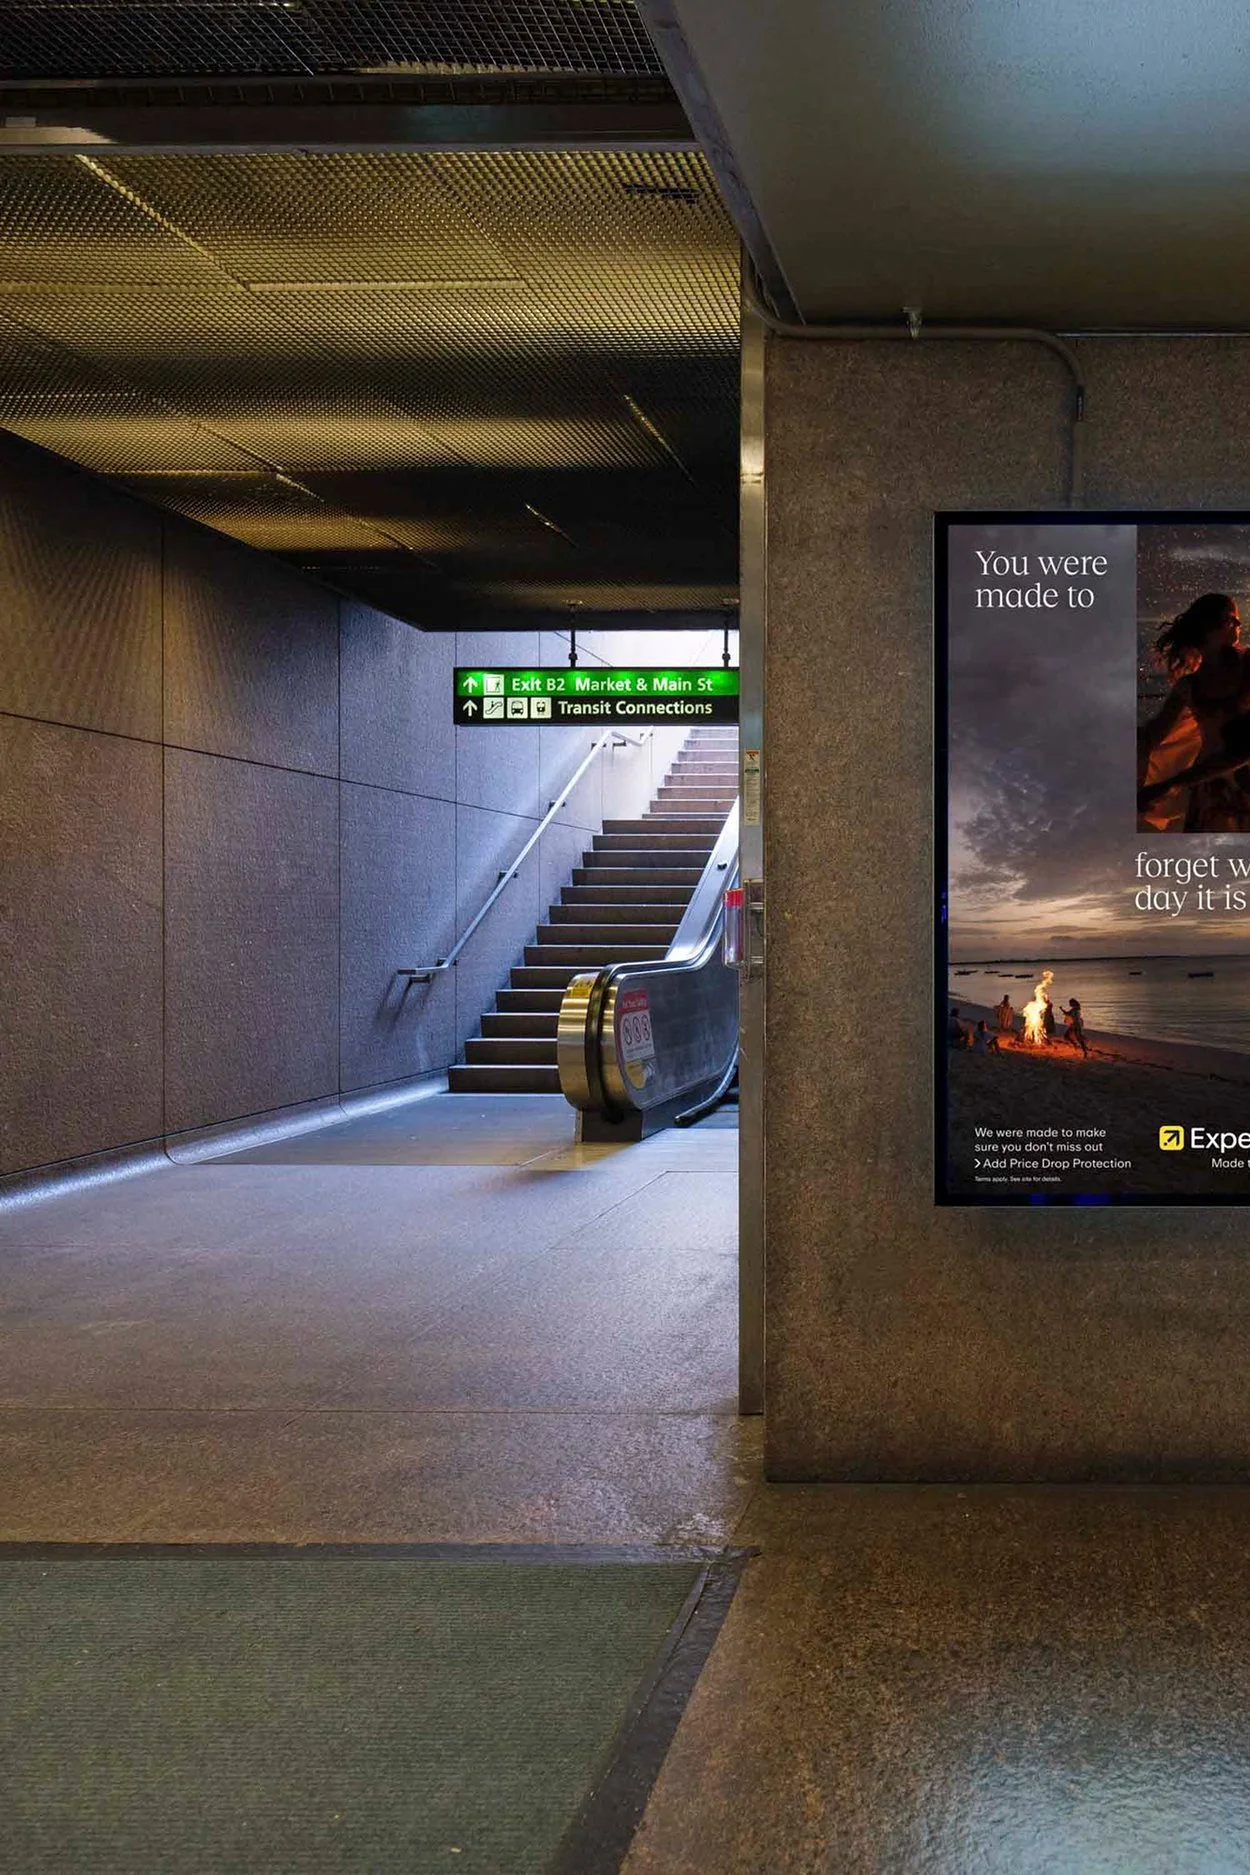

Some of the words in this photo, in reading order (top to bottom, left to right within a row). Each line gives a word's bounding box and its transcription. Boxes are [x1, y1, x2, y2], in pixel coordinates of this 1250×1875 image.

[975, 550, 1030, 576] You
[1038, 555, 1108, 576] were
[975, 582, 1059, 609] made
[1067, 586, 1095, 609] to
[512, 677, 542, 692] Exit
[546, 677, 566, 692] B2
[575, 676, 632, 692] Market
[636, 677, 648, 692] &
[653, 677, 692, 692] Main
[697, 677, 713, 692] St
[558, 700, 612, 715] Transit
[616, 700, 713, 715] Connections
[1135, 851, 1219, 885] forget
[1135, 885, 1188, 917] day
[1197, 884, 1216, 911] it
[1223, 884, 1248, 911] is
[974, 1127, 994, 1138] We
[995, 1129, 1024, 1138] were
[1026, 1127, 1059, 1138] made
[1061, 1128, 1074, 1138] to
[1076, 1127, 1107, 1138] make
[974, 1143, 999, 1152] sure
[1001, 1143, 1022, 1154] you
[1024, 1141, 1054, 1152] don't
[1056, 1141, 1082, 1152] miss
[1084, 1142, 1104, 1152] out
[983, 1158, 1007, 1169] Add
[1009, 1158, 1039, 1169] Price
[1041, 1158, 1070, 1170] Drop
[1072, 1158, 1132, 1169] Protection
[1211, 1157, 1245, 1168] Made
